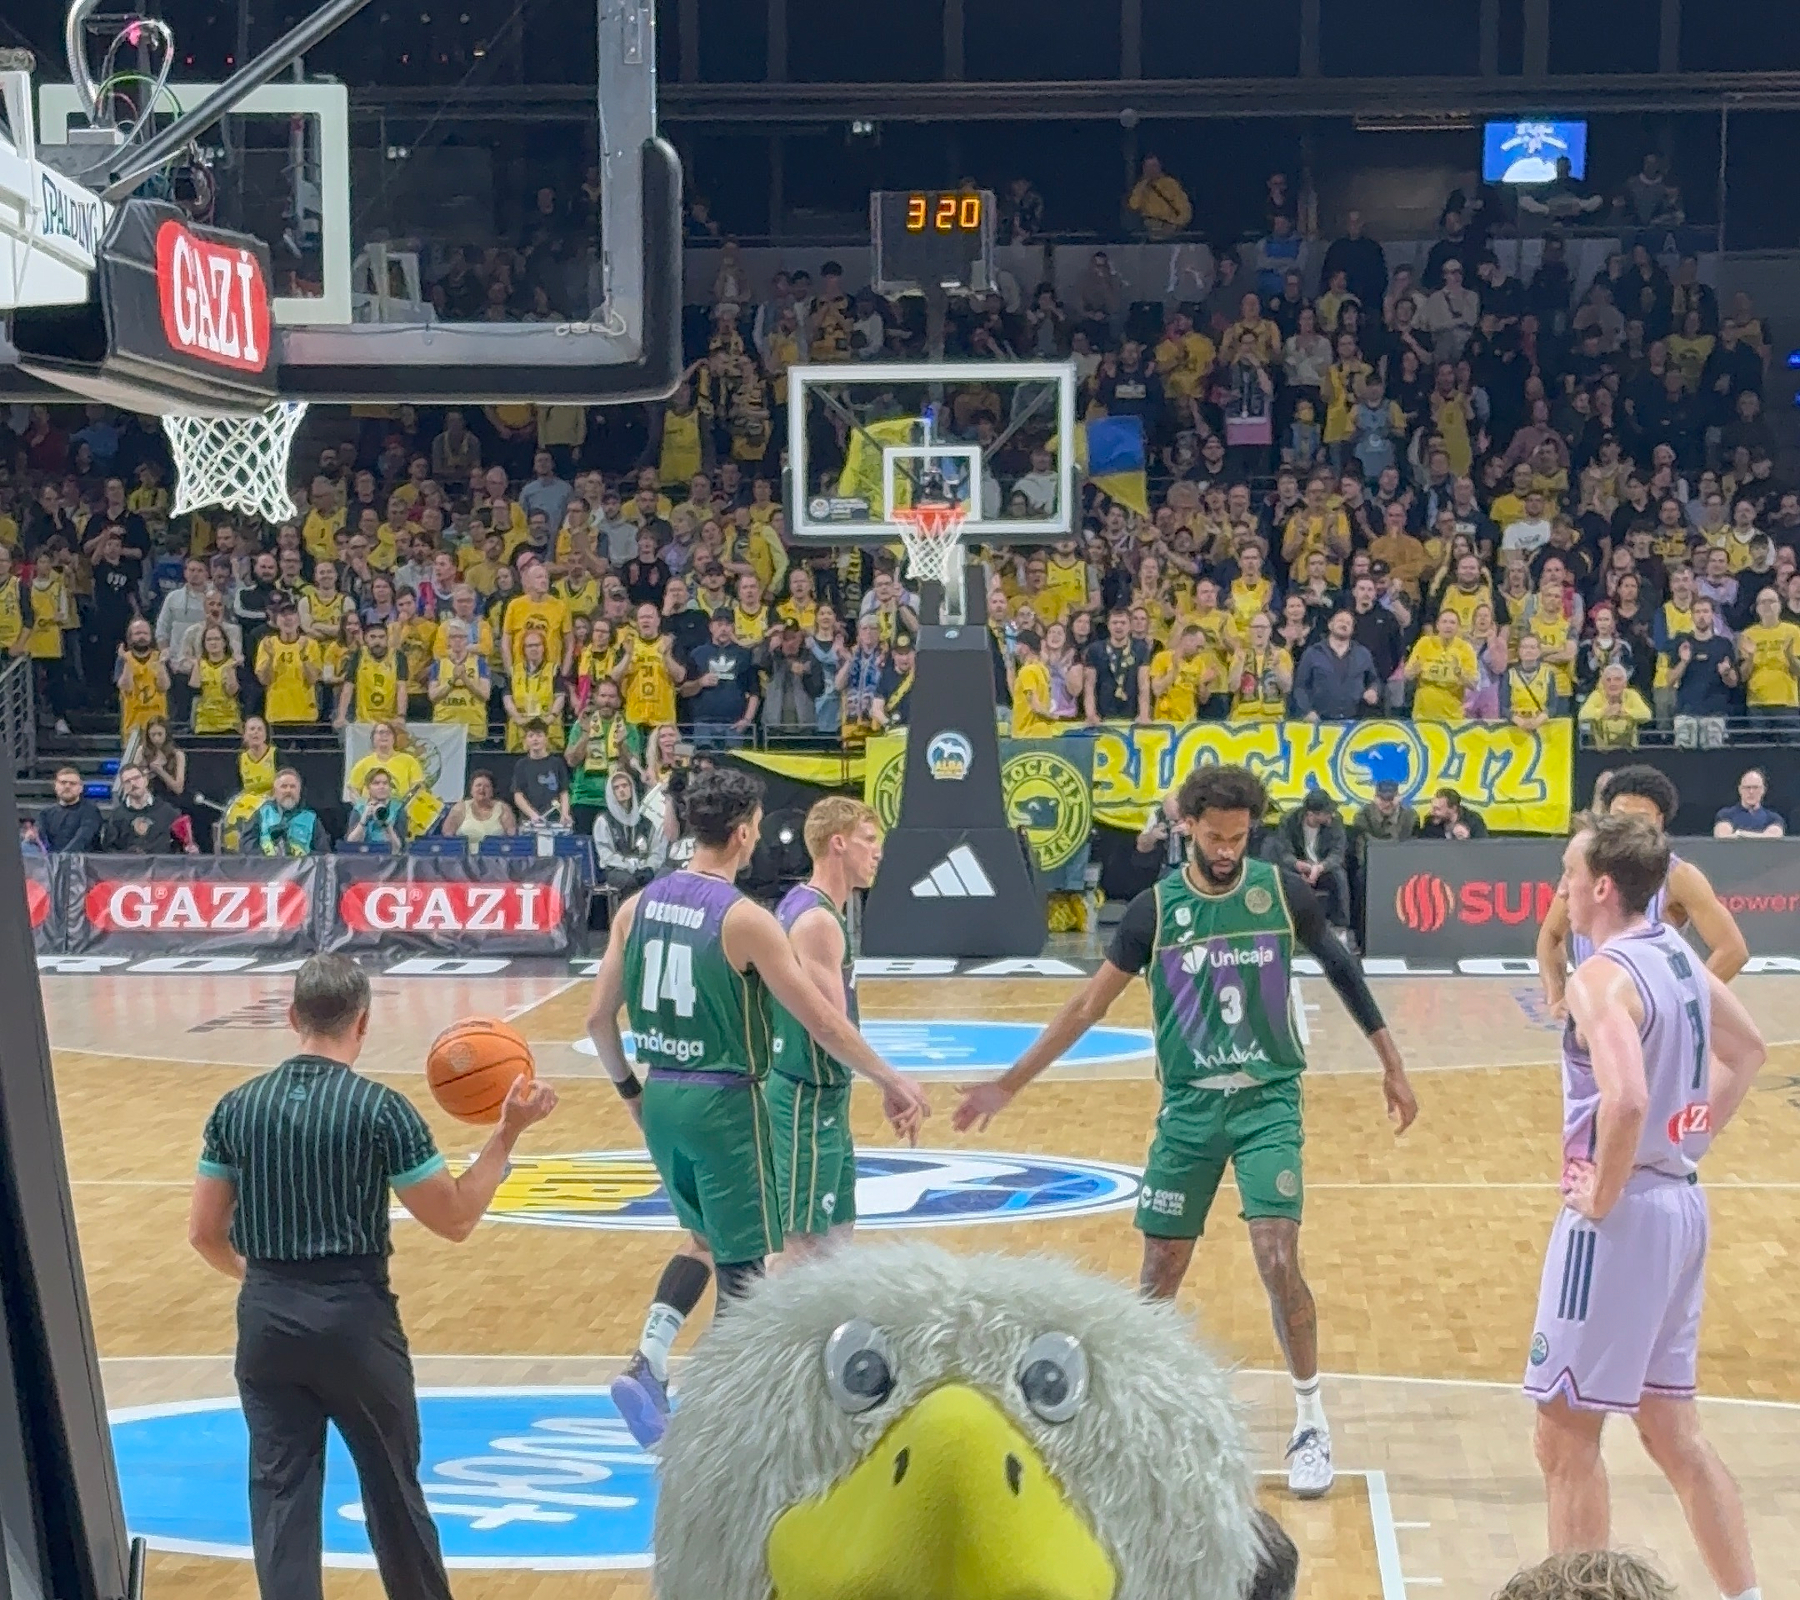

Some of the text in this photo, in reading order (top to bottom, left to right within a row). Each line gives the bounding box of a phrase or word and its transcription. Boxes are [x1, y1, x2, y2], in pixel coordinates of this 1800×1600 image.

[42, 172, 98, 258] SPALDING
[172, 235, 259, 362] GAZİ
[1002, 760, 1054, 801] LOCK
[110, 882, 286, 929] GAZİ
[364, 884, 542, 931] GAZİ
[642, 939, 697, 1017] 14
[1210, 945, 1274, 968] Unicaja
[1219, 986, 1244, 1025] 3
